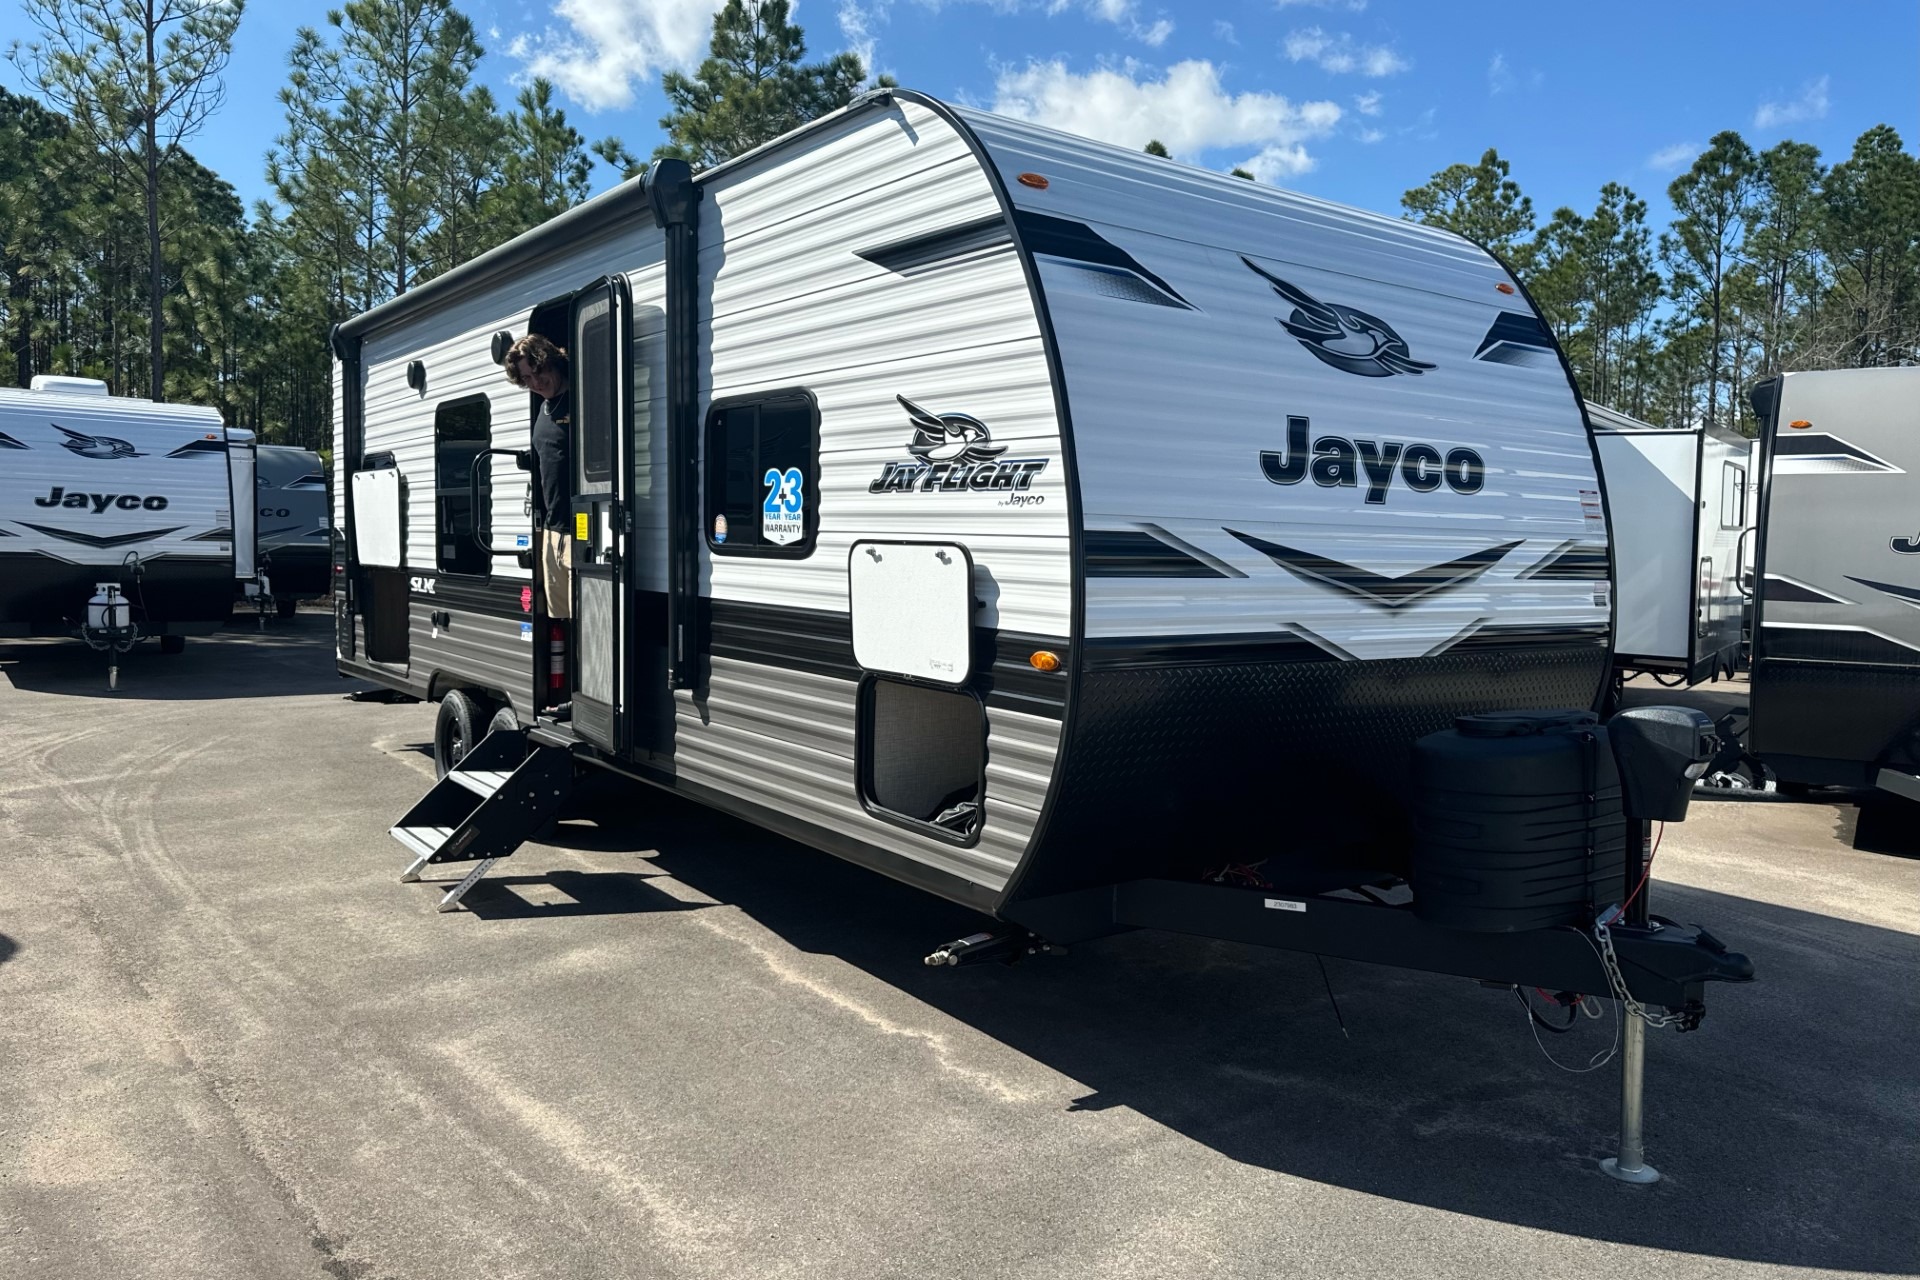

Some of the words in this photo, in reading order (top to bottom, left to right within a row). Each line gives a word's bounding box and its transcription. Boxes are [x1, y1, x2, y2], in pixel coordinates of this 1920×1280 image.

[1259, 414, 1486, 505] Jayco
[868, 462, 931, 494] JAY
[920, 458, 1050, 493] FLIGHT
[34, 486, 169, 514] Jayco
[1004, 492, 1045, 508] Jayco
[764, 513, 781, 521] YEAR
[784, 513, 802, 521] YEAR
[764, 524, 801, 534] WARRANTY
